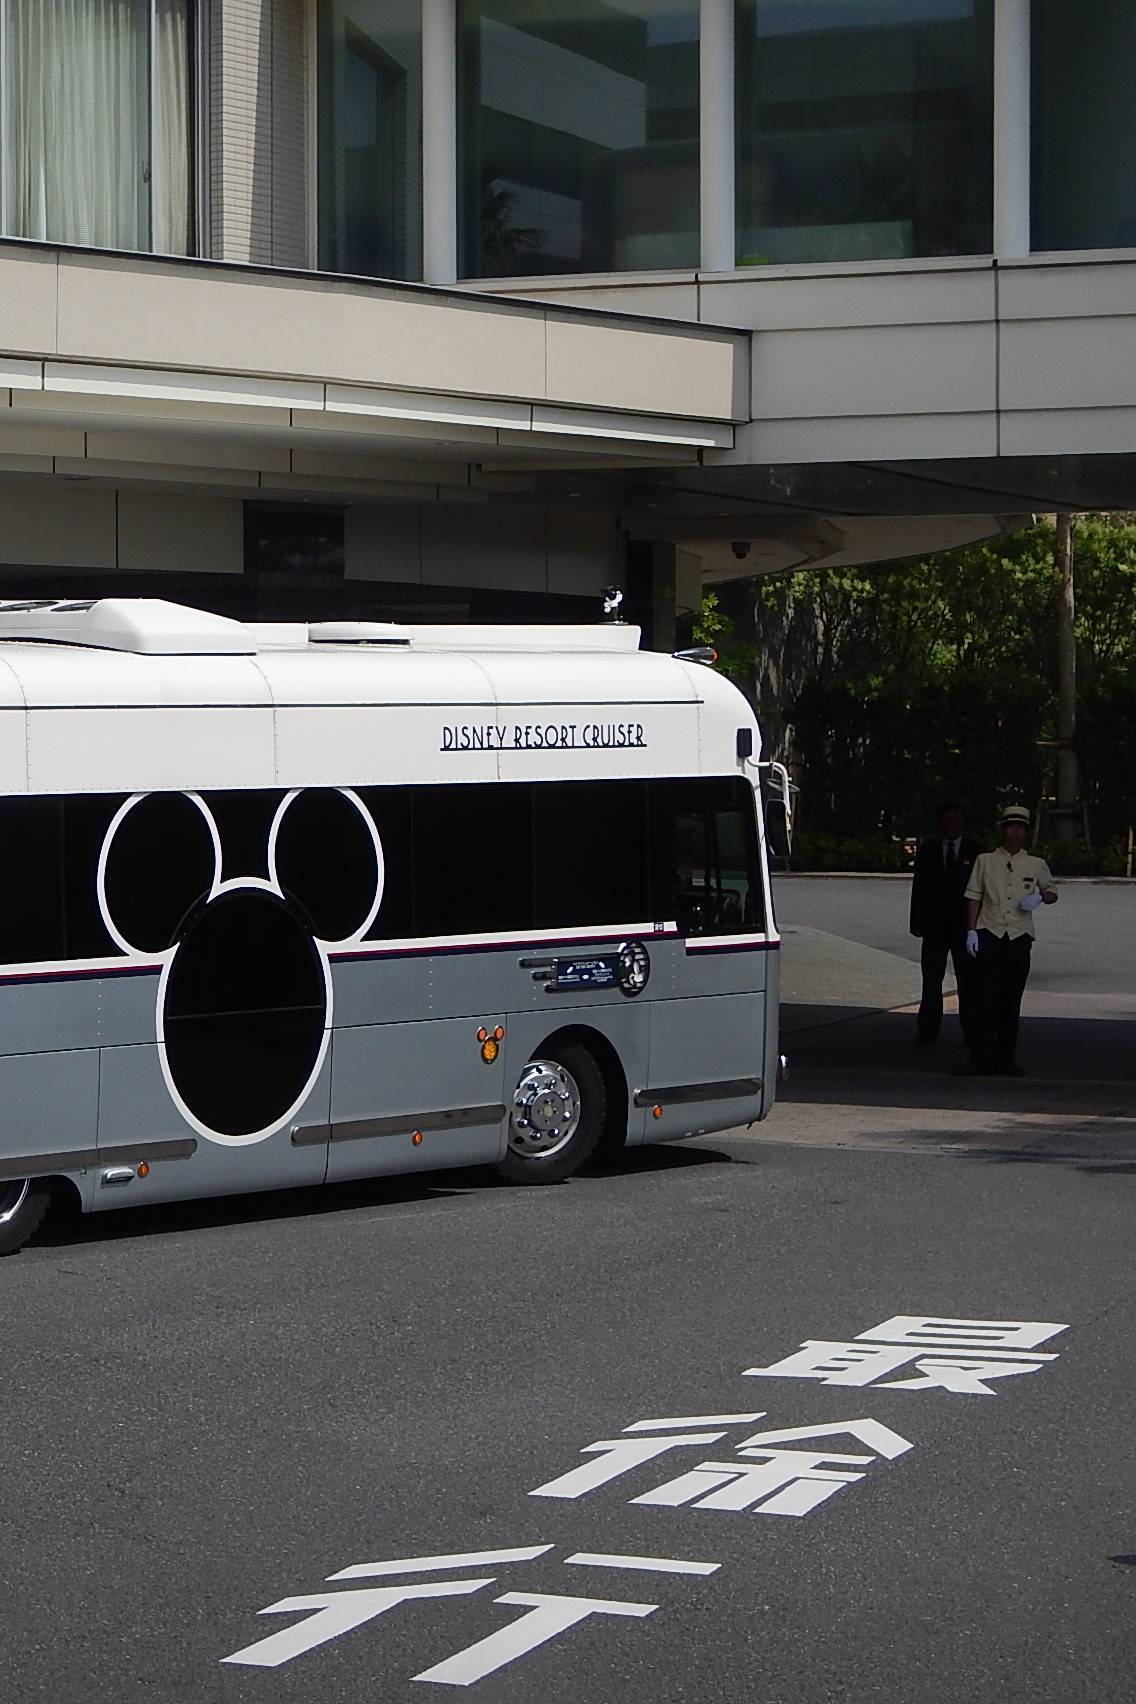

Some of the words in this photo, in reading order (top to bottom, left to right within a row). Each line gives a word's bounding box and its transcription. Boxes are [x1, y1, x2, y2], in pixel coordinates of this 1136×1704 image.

[443, 726, 506, 748] DISNEY
[514, 725, 576, 748] RESORT
[583, 724, 644, 746] CRUISER
